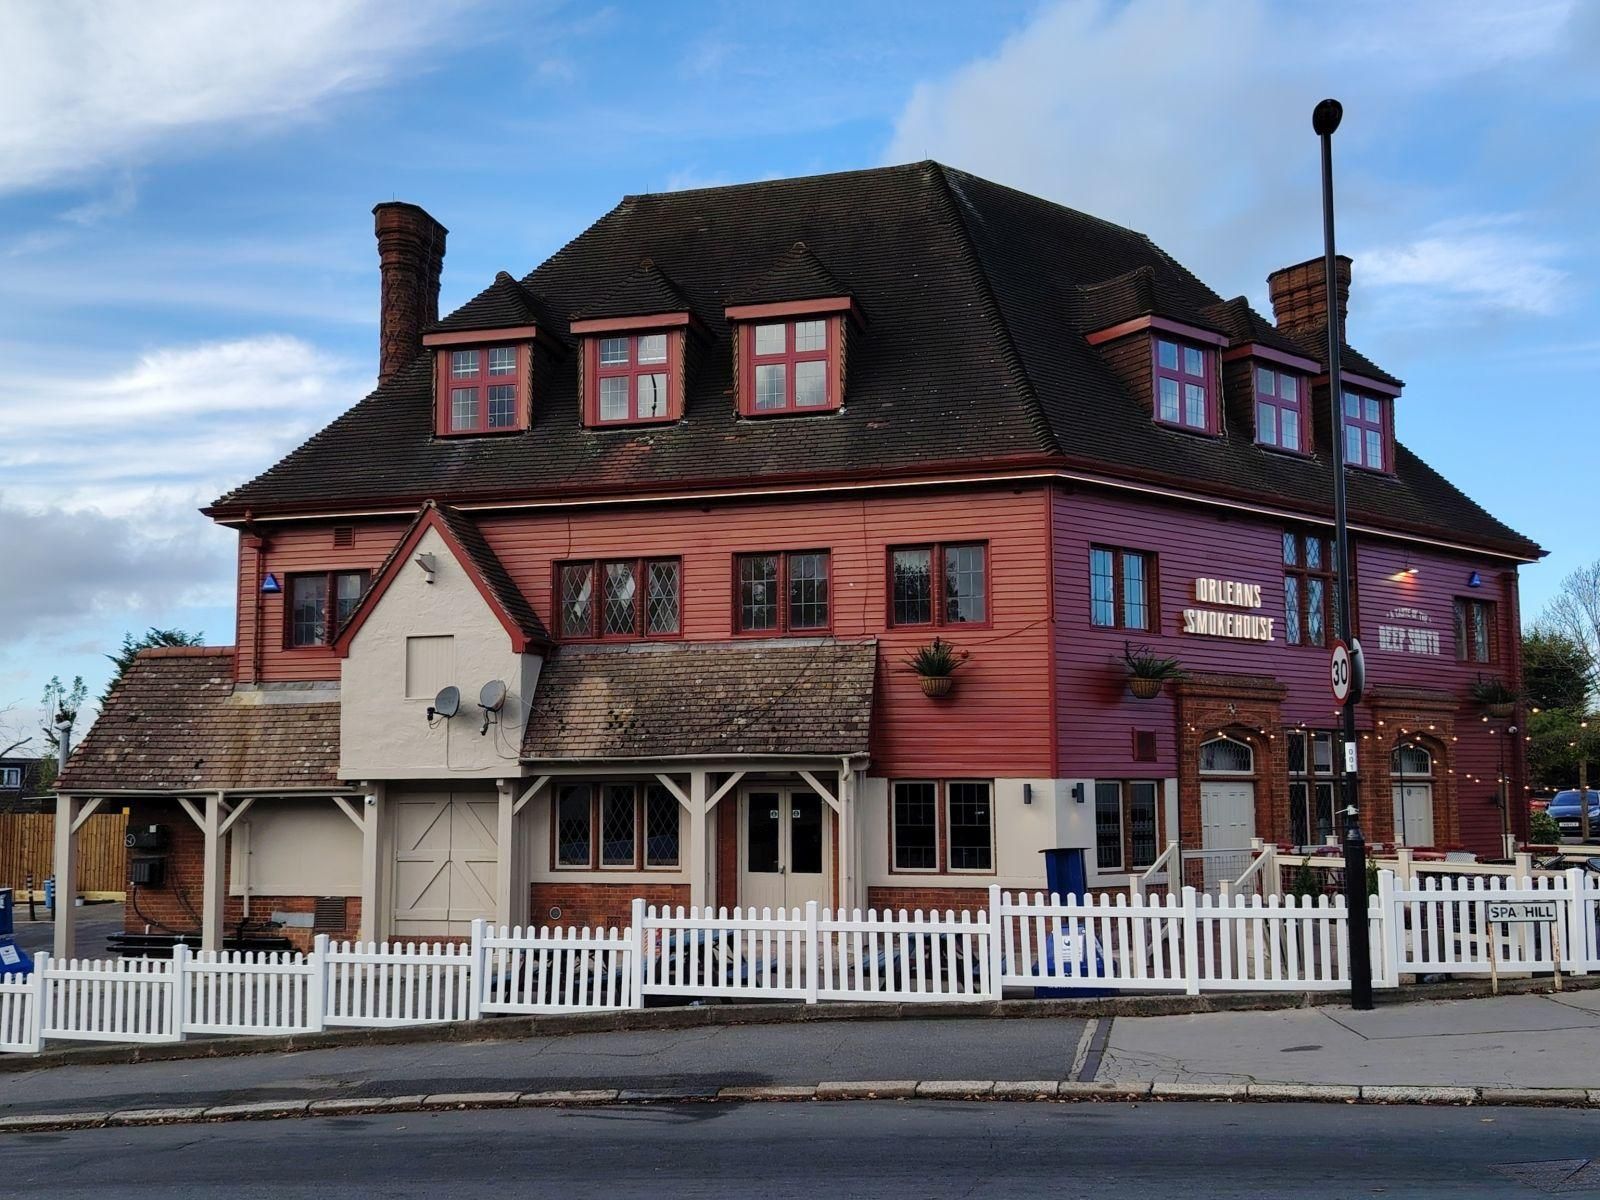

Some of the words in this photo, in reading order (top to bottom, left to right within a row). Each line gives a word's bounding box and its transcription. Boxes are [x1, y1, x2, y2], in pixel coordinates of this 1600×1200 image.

[1196, 577, 1261, 608] ORLEANS
[1183, 609, 1275, 641] SMOKEHOUSE
[1379, 625, 1405, 652] DEEP
[1408, 628, 1440, 655] SOUTH
[1333, 659, 1348, 686] 30
[1491, 906, 1517, 918] SPA
[1524, 906, 1553, 918] HILL
